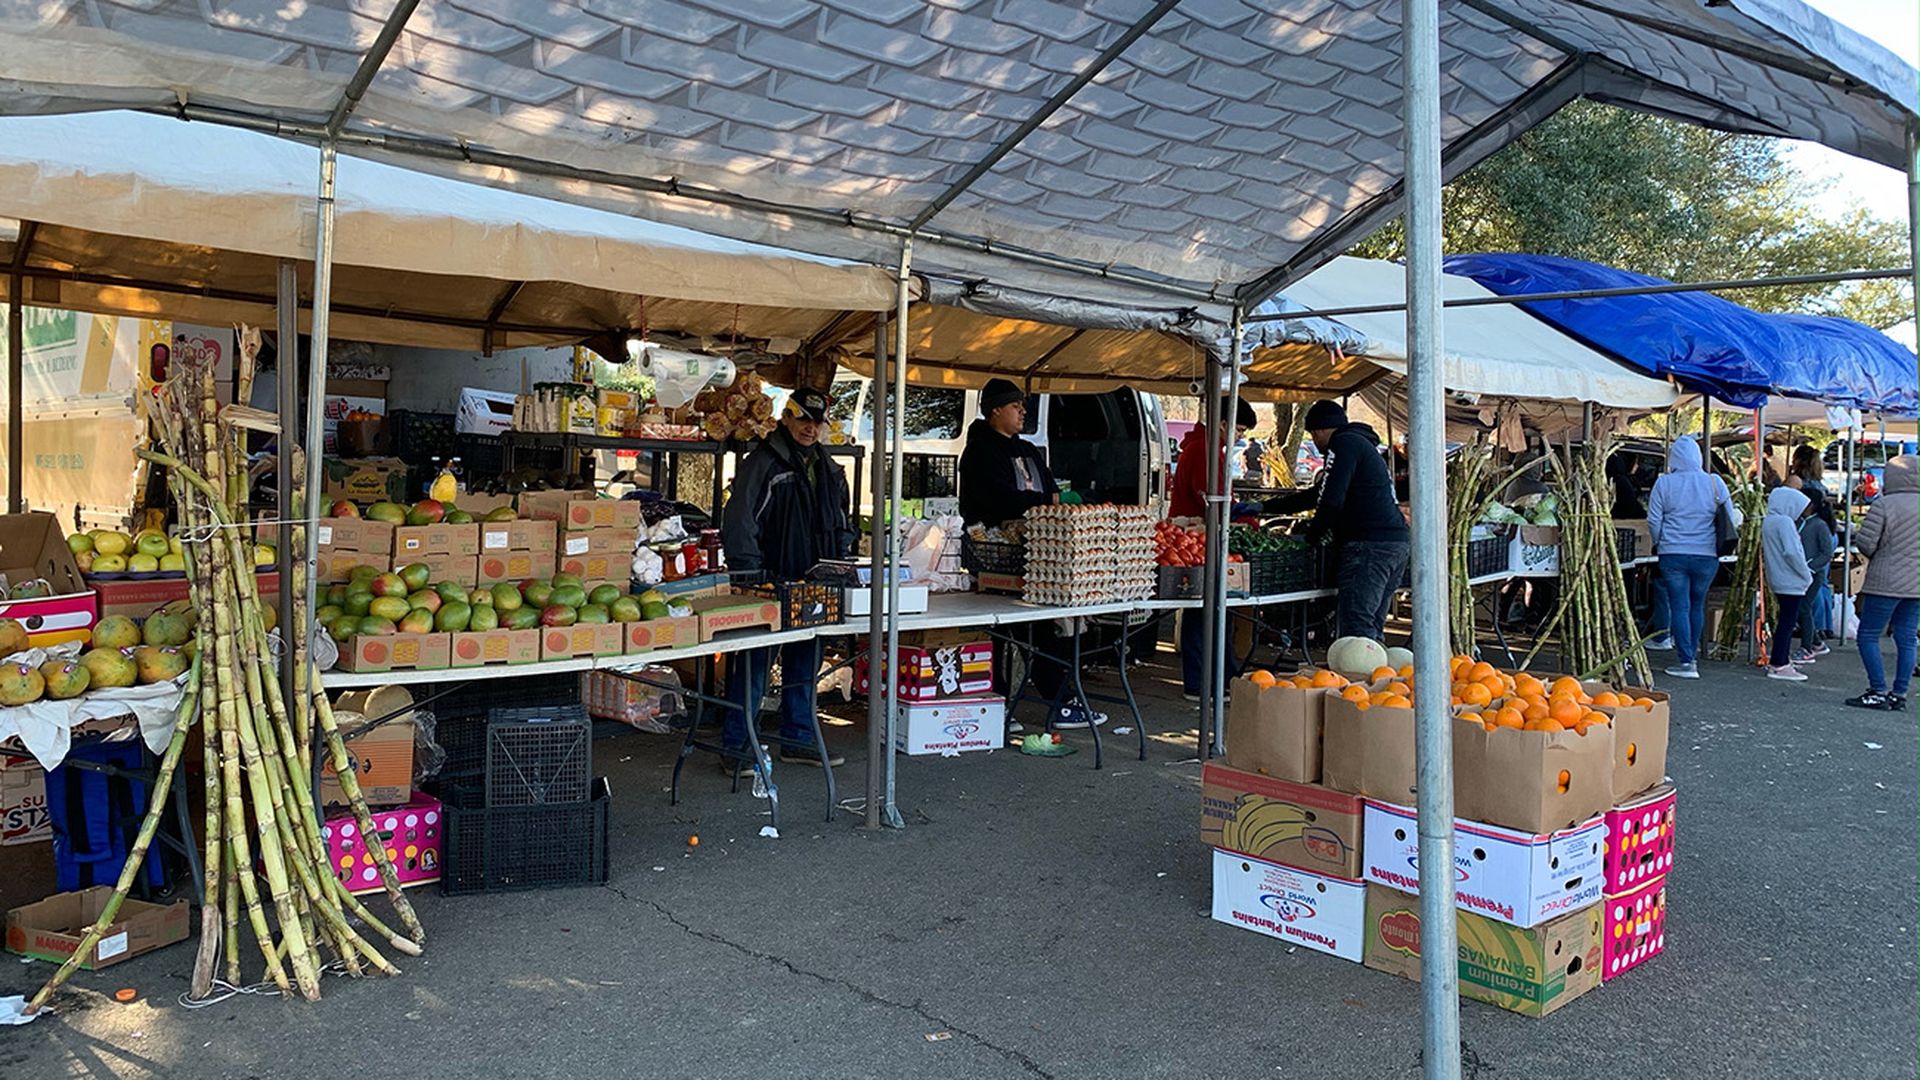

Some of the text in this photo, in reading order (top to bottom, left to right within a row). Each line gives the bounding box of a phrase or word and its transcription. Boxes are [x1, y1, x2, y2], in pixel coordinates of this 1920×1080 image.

[924, 739, 990, 751] Premium Plantains
[22, 794, 44, 807] SU
[1307, 839, 1338, 857] Dole
[1257, 883, 1317, 906] World Direct
[1456, 891, 1514, 921] Premiu
[1231, 910, 1337, 950] Premium Plantains
[1382, 922, 1414, 943] Monte
[35, 935, 78, 954] MANGO
[1457, 945, 1536, 980] BANANAS
[1468, 966, 1536, 998] Premium
